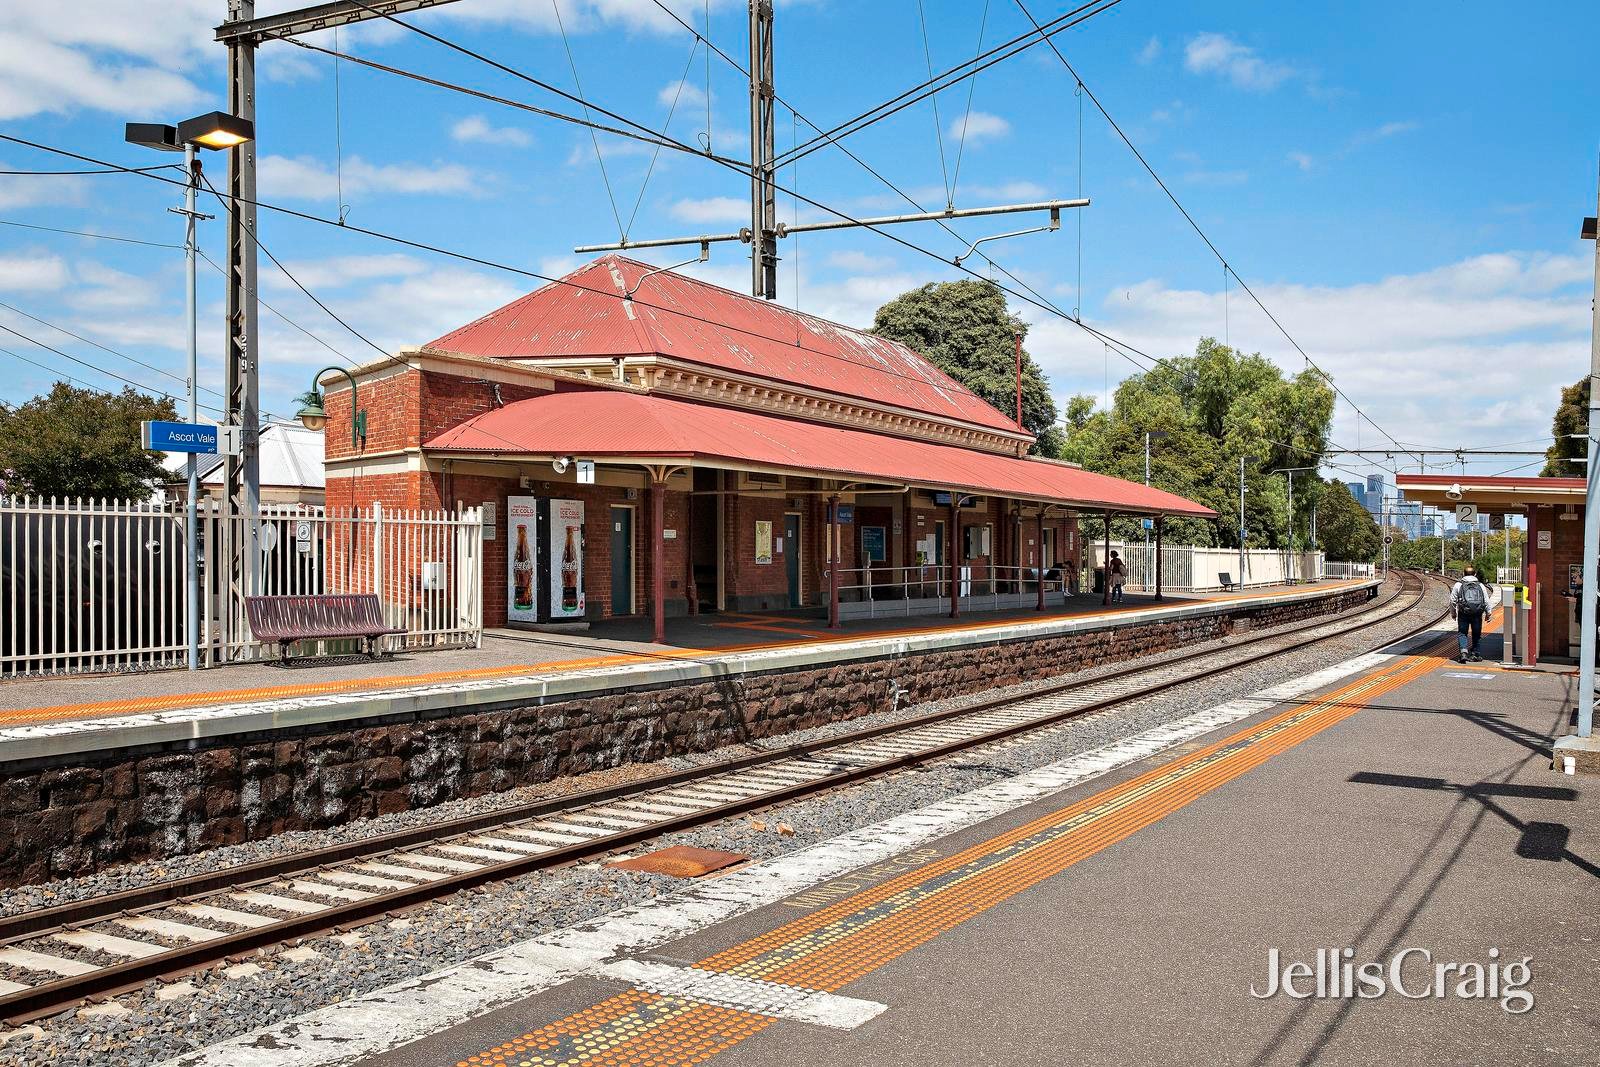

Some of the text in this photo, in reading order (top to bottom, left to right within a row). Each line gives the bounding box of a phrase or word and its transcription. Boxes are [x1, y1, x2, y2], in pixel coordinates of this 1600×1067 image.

[168, 431, 216, 444] Ascot Vale
[224, 430, 232, 452] 1
[582, 465, 589, 482] 1
[1460, 506, 1473, 523] 2
[1492, 517, 1502, 529] 2
